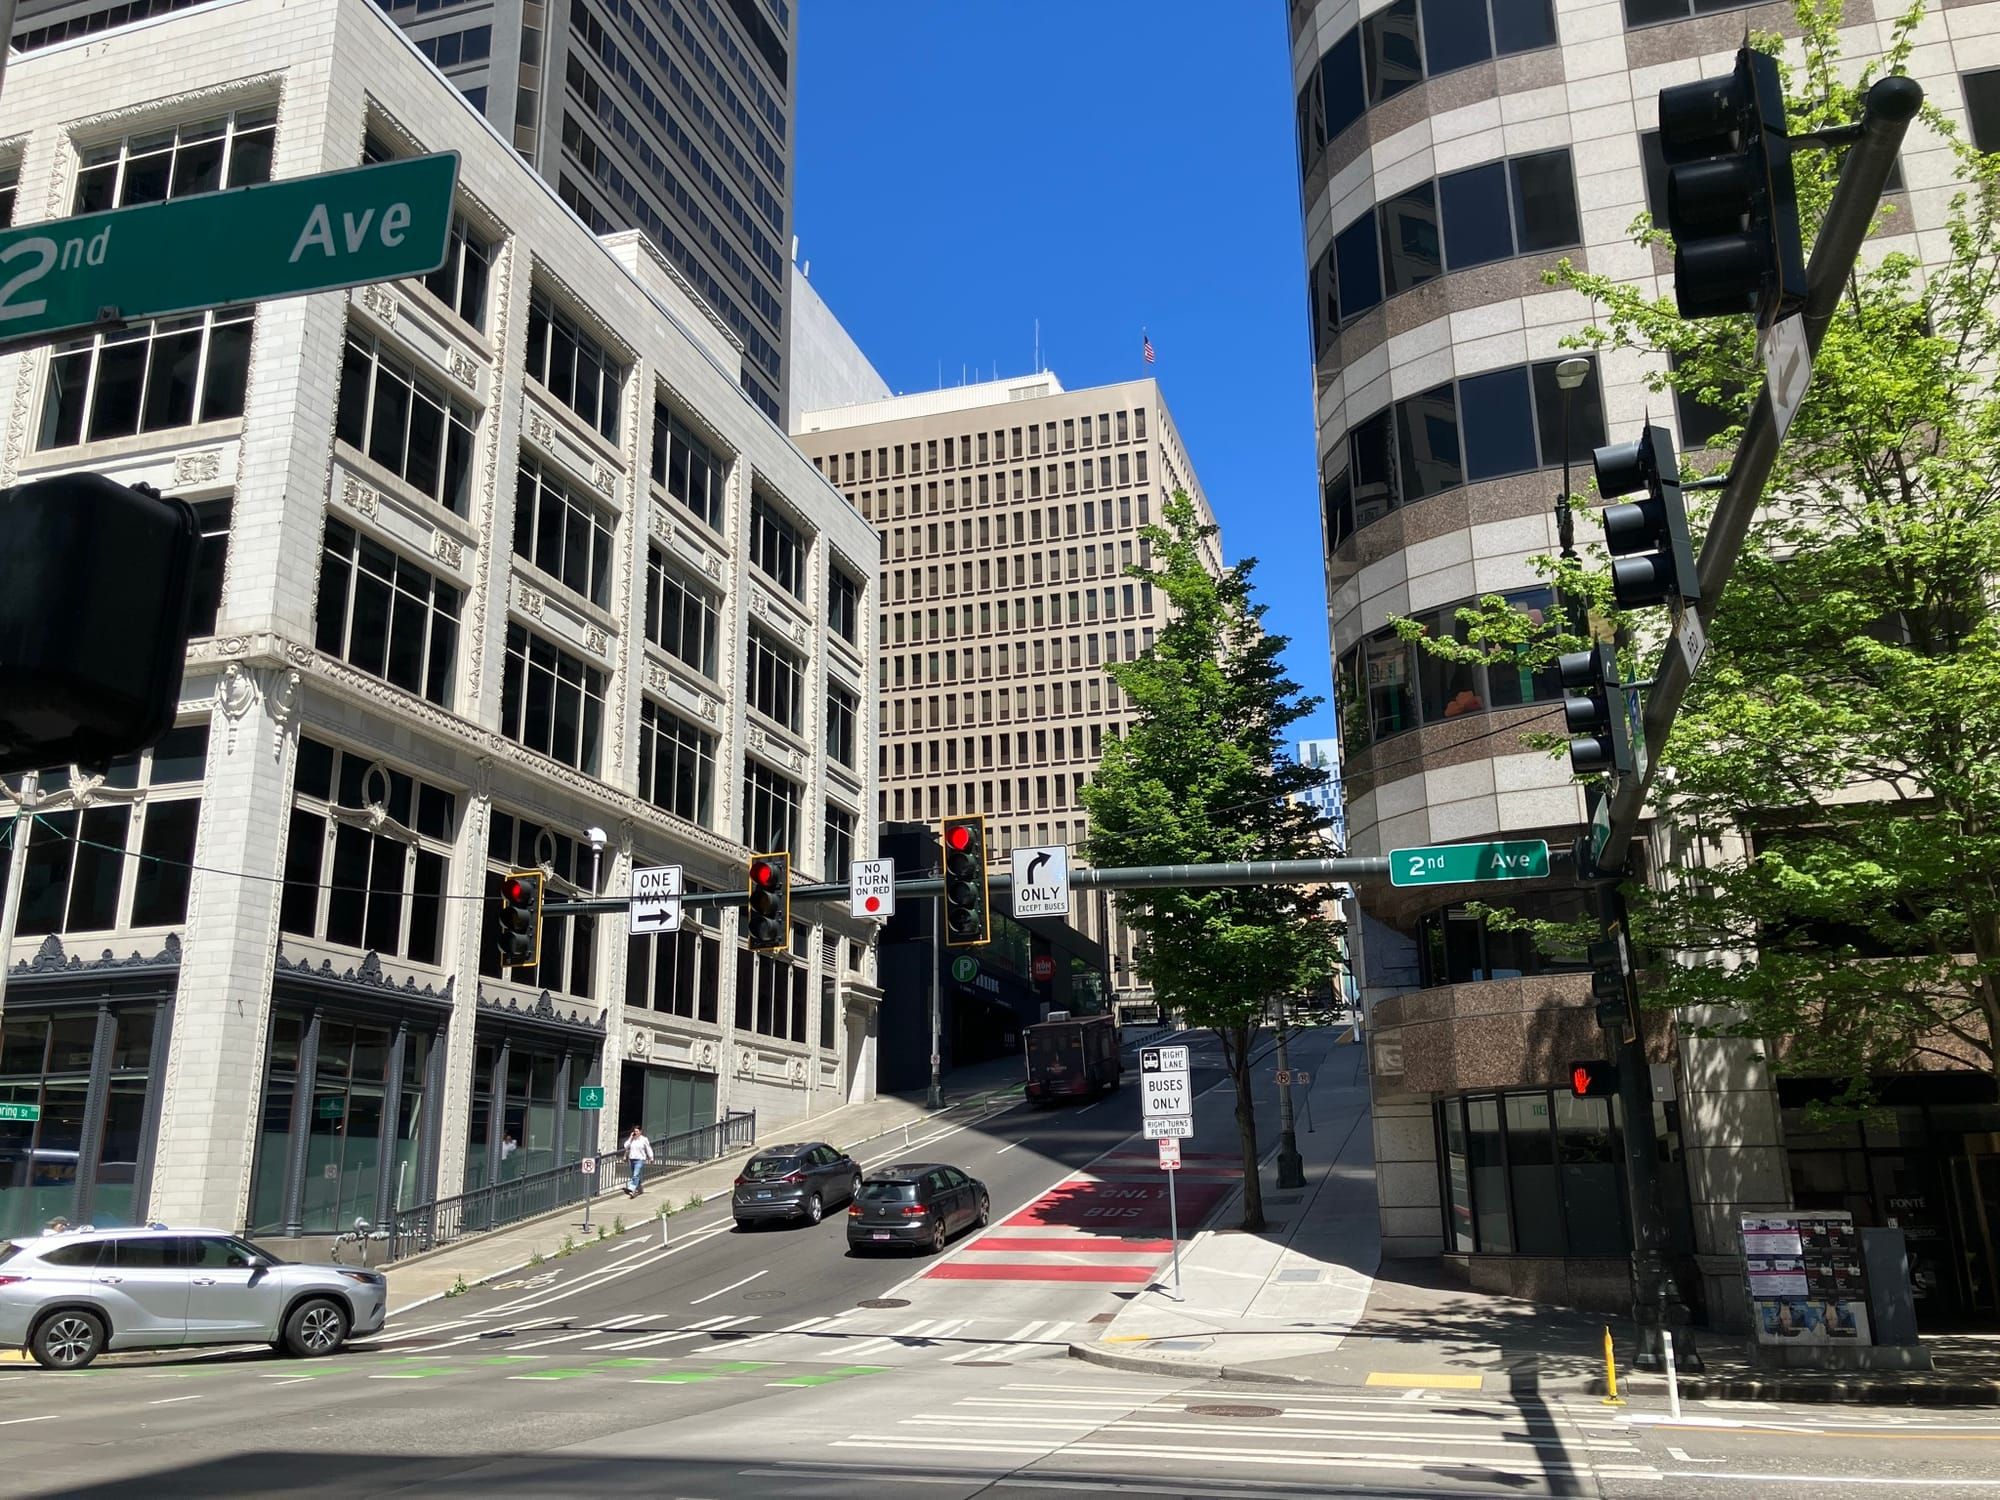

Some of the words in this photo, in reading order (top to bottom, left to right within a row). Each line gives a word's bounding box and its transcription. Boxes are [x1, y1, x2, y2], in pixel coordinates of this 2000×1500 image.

[0, 225, 112, 321] 2nd
[288, 202, 412, 263] Ave
[864, 863, 881, 874] NO
[1408, 855, 1445, 876] 2nd
[1491, 853, 1530, 869] Ave
[640, 873, 671, 888] ONE
[857, 875, 889, 886] TURN
[856, 887, 869, 896] ON
[873, 886, 890, 895] RED
[1021, 887, 1060, 901] ONLY
[639, 889, 671, 906] WAY
[1018, 903, 1042, 913] EXCEPT
[1045, 902, 1065, 911] BUSES
[1162, 1050, 1184, 1059] RIGHT
[1164, 1060, 1183, 1069] LANE
[1149, 1080, 1183, 1092] BUSES
[1153, 1097, 1181, 1110] ONLY
[1151, 1127, 1186, 1136] PERMITTED
[1083, 1207, 1144, 1217] BUS
